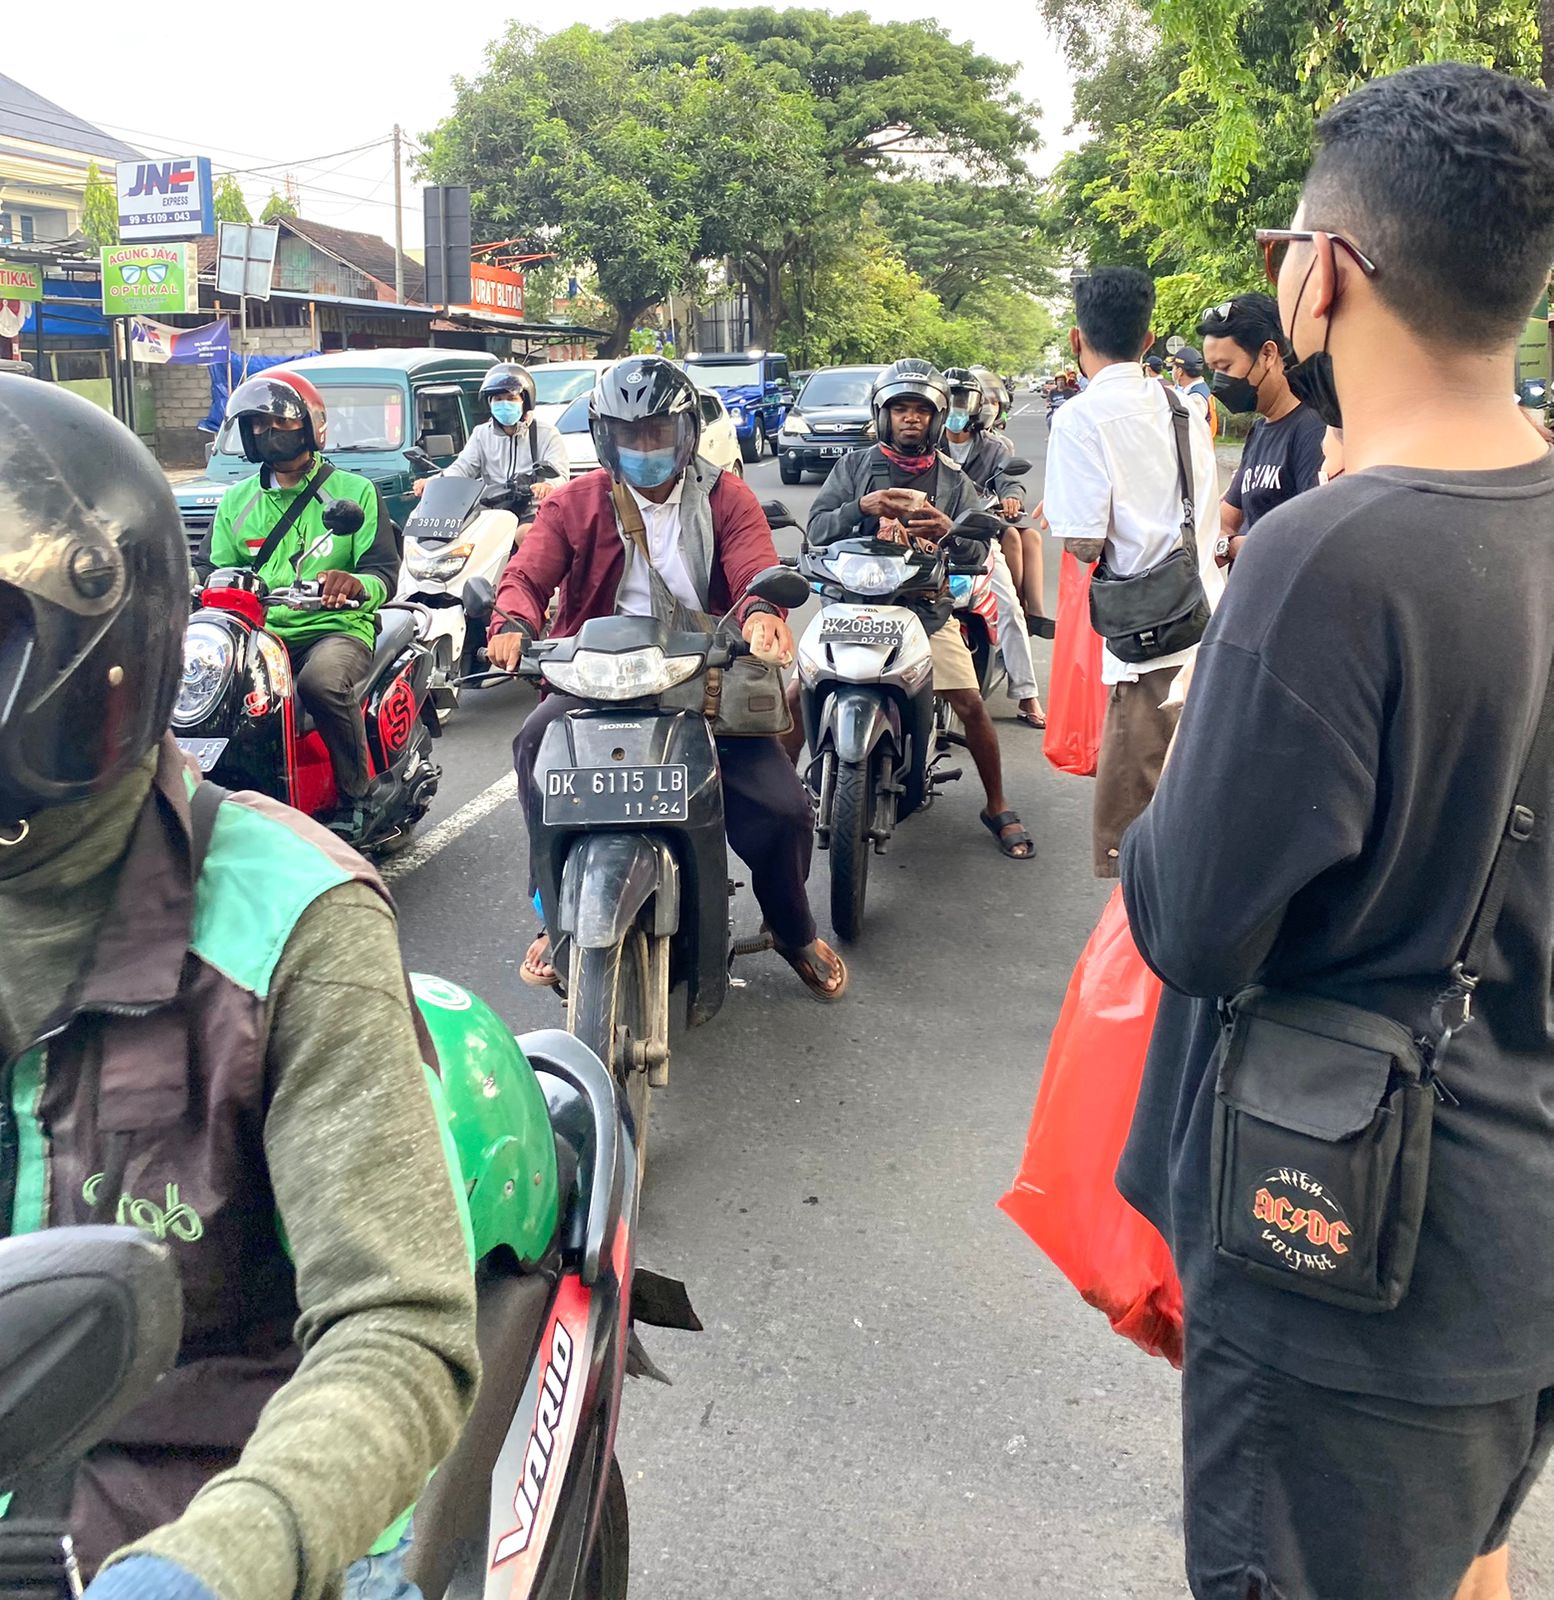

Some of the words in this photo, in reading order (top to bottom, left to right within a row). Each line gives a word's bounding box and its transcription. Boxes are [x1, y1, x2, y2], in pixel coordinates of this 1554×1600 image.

[122, 161, 195, 197] JNE
[162, 196, 189, 207] EXPRESS
[109, 247, 149, 266] AGUNG
[151, 247, 179, 263] JAYA
[110, 283, 179, 297] OPTIKAL
[475, 277, 496, 306] URAT
[496, 282, 523, 310] BLITAR
[418, 519, 440, 528] 3970
[598, 723, 642, 731] HONDA
[549, 773, 576, 796] DK
[592, 771, 644, 794] 6115
[658, 771, 683, 792] LB
[1279, 1169, 1323, 1198] HIGH
[491, 1317, 574, 1569] VARIO
